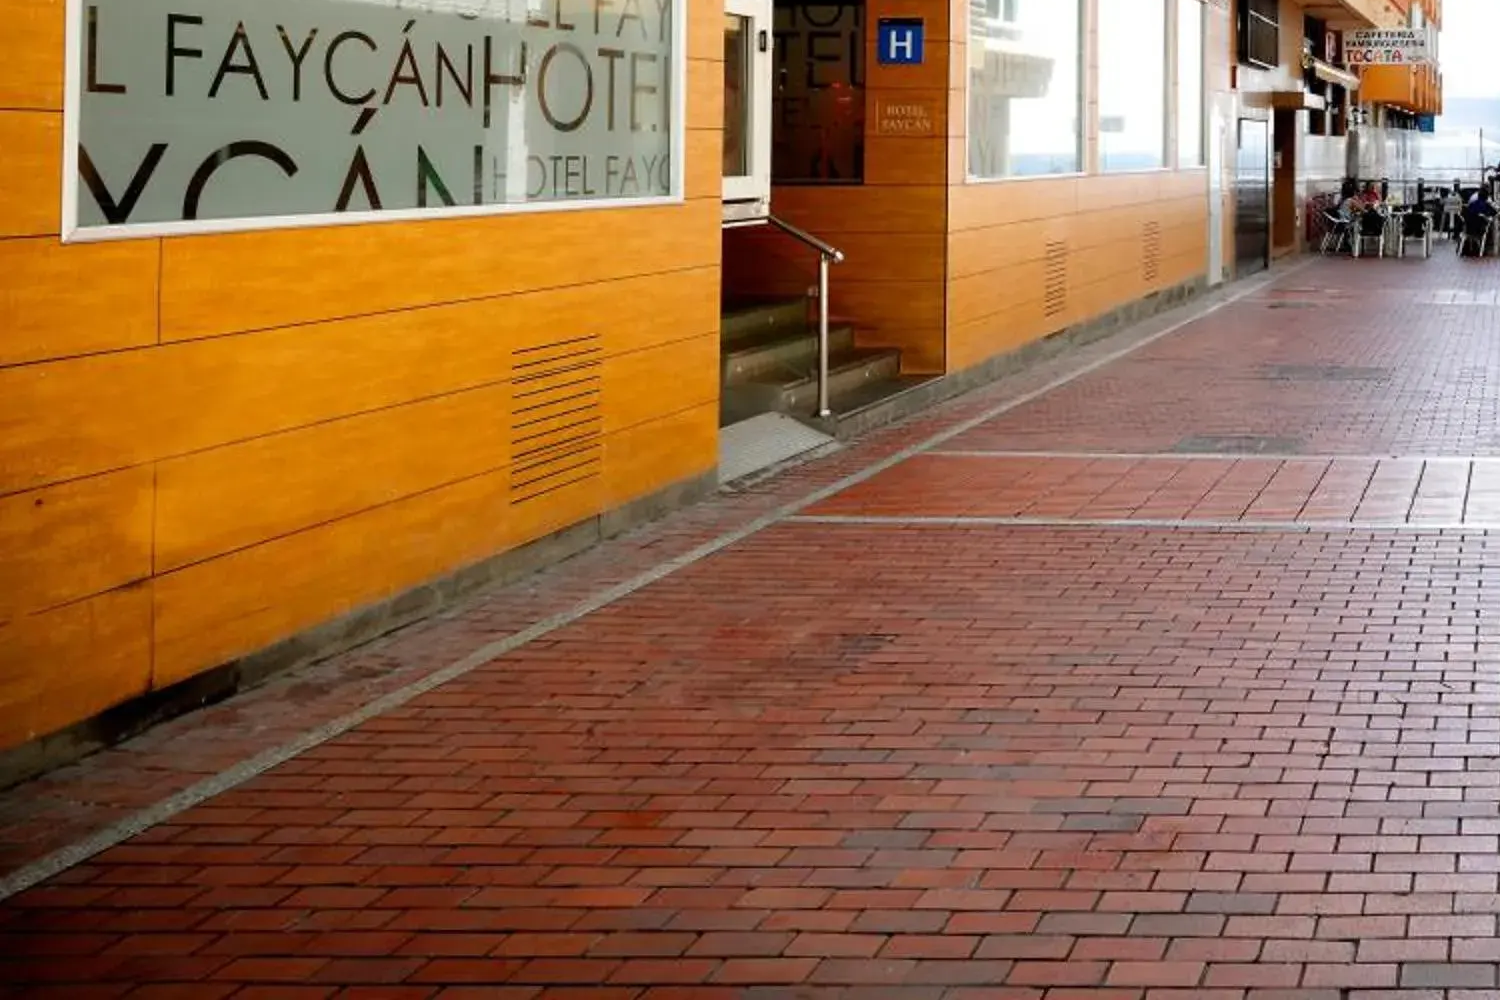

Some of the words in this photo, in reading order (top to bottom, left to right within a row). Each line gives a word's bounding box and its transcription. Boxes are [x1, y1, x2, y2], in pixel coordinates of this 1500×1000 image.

[889, 30, 913, 59] H
[1346, 49, 1403, 63] TOCATA
[165, 13, 474, 109] FAYCÁN
